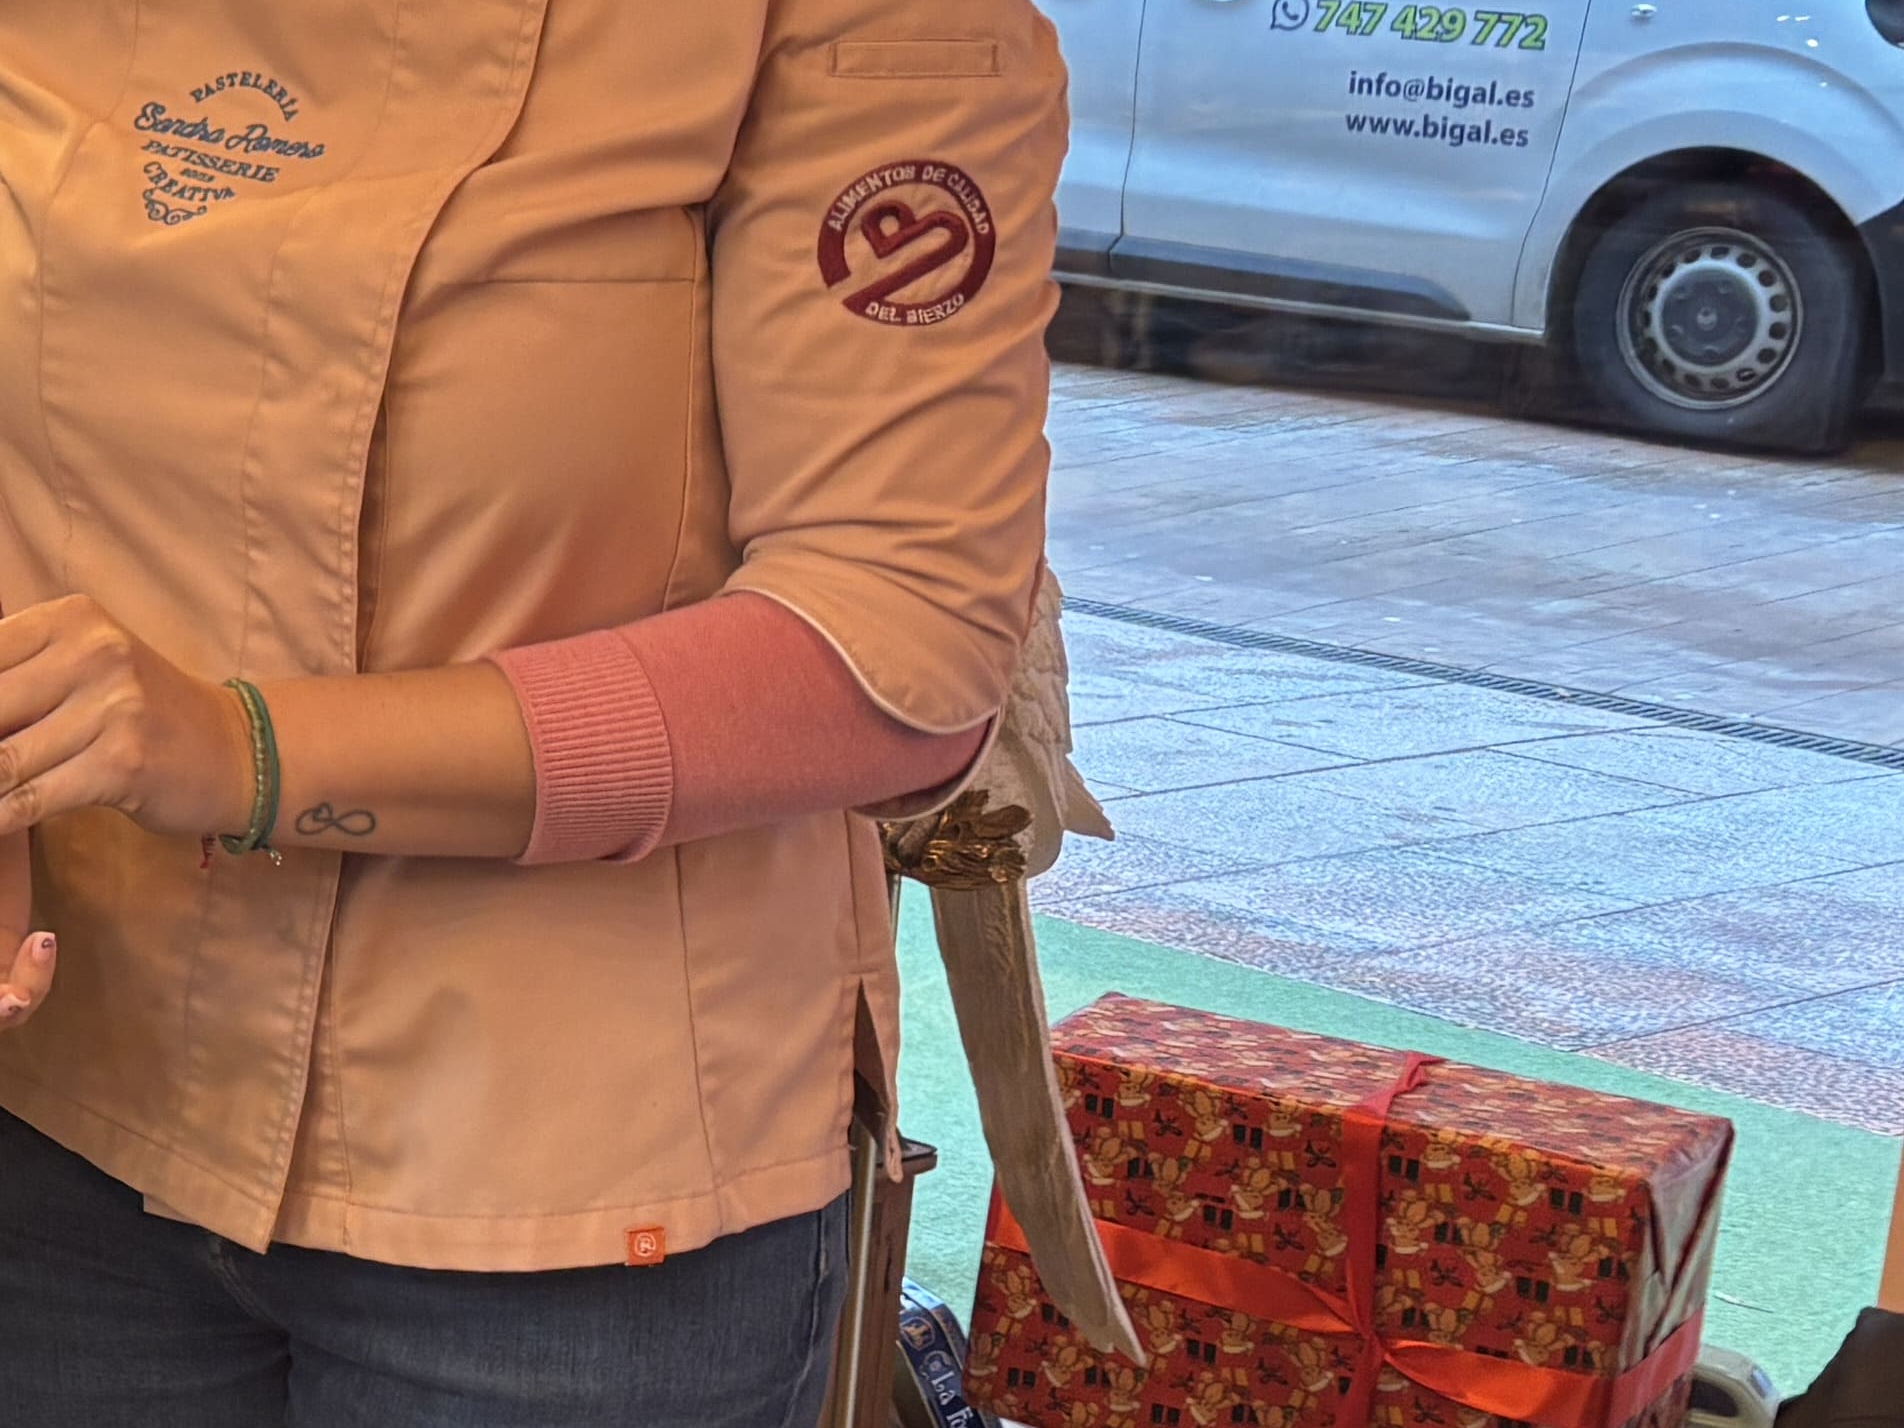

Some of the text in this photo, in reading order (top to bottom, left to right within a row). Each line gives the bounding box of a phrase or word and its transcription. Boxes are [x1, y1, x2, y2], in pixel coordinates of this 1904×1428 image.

[1391, 4, 1467, 43] 429
[1470, 10, 1549, 51] 772
[189, 71, 299, 122] PASTELERÍA
[1348, 70, 1535, 109] info@bigal.es
[134, 101, 326, 159] Sandra Romero
[1345, 112, 1530, 148] www.bigal.es
[141, 139, 280, 183] PATISSERIE
[143, 160, 236, 203] CREATIVA
[828, 164, 991, 236] ALIMENTOS DE CALIDAD
[865, 292, 965, 325] DEL BIERZO
[929, 1370, 956, 1406] La
